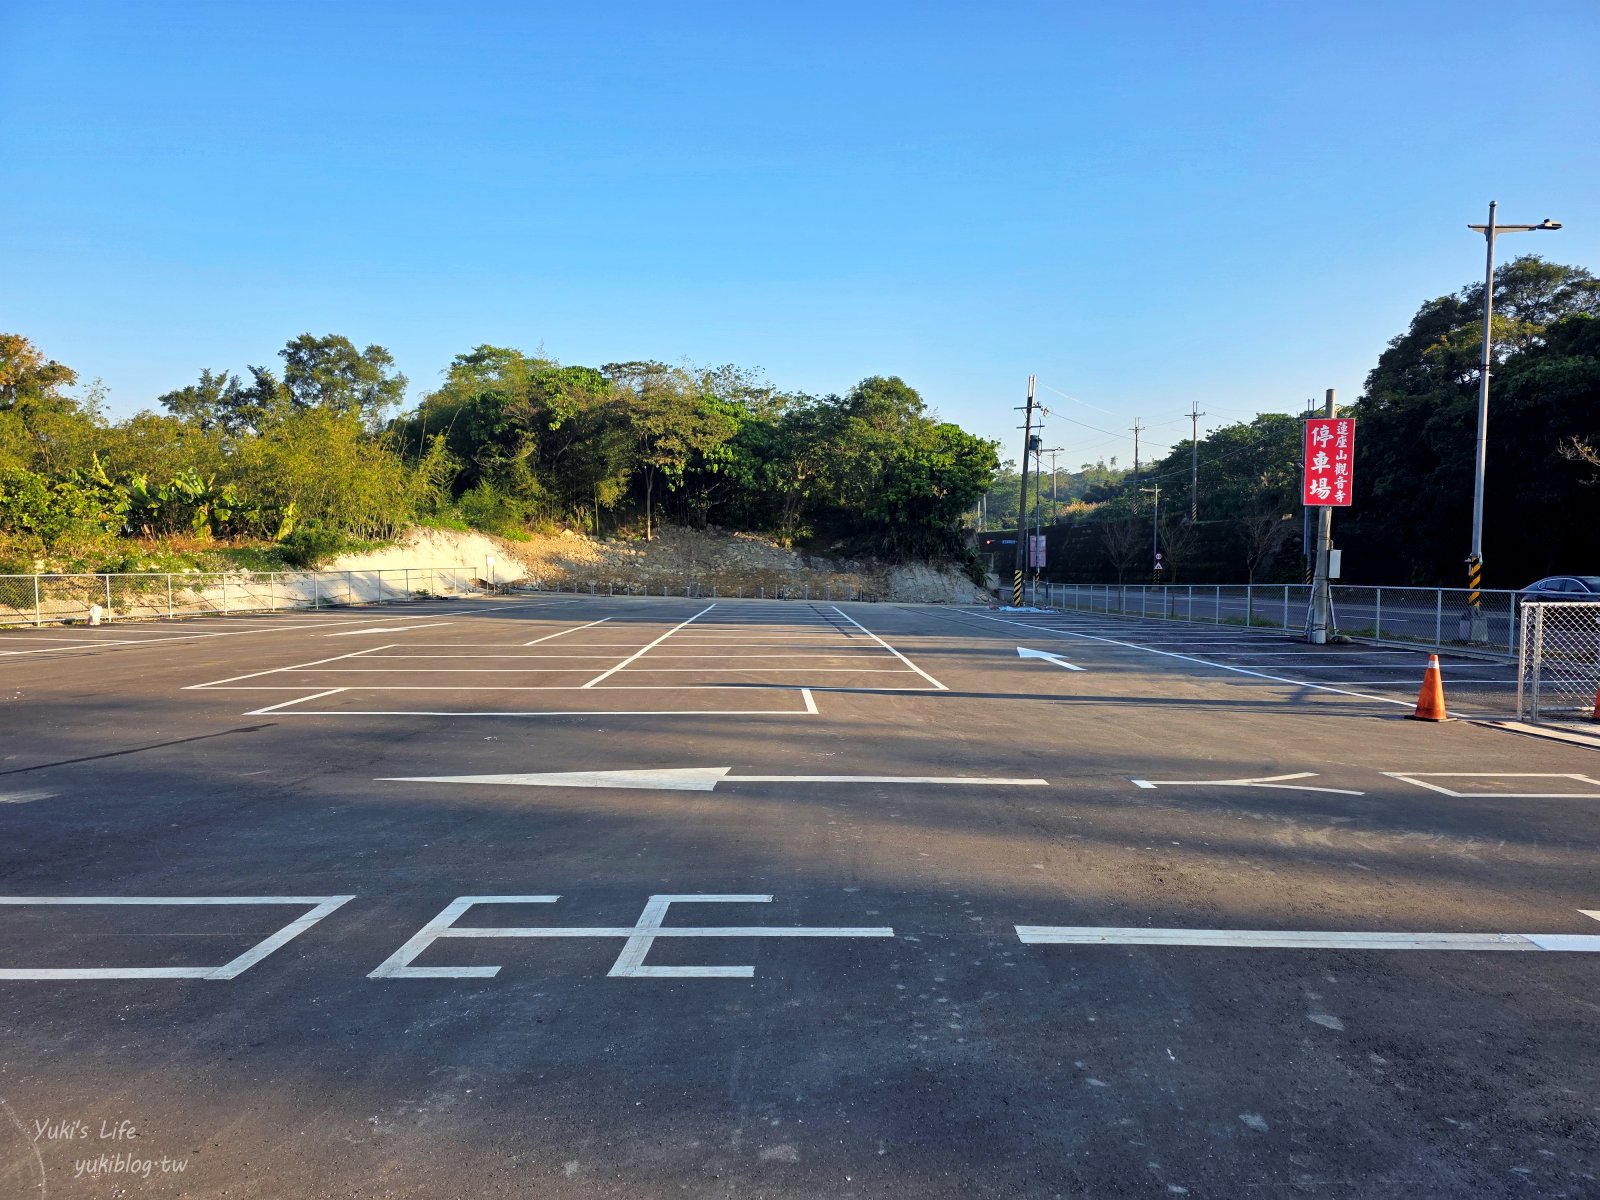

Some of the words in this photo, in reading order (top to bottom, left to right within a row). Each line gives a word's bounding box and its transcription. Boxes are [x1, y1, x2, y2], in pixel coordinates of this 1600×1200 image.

[1310, 425, 1334, 499] 停車場
[1334, 421, 1349, 503] 蓮座山觀音寺
